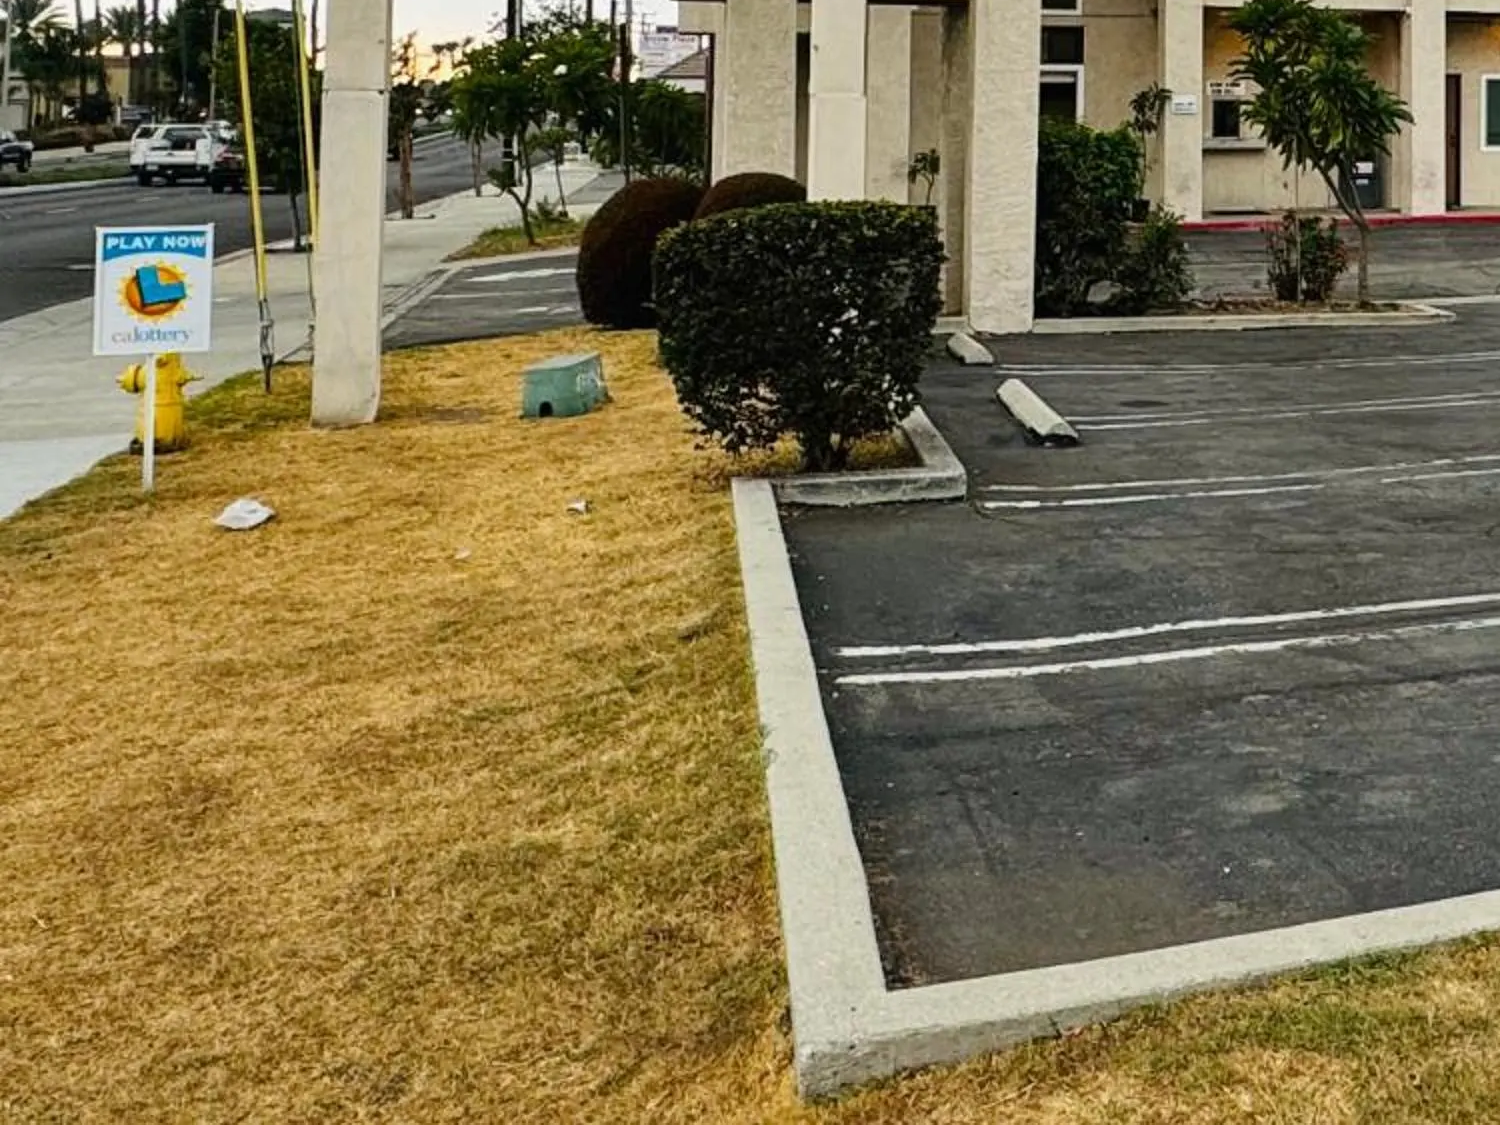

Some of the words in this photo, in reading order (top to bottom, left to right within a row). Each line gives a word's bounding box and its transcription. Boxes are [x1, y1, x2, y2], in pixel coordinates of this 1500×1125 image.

[106, 235, 157, 250] PLAY
[163, 234, 206, 249] NOW
[111, 326, 191, 345] calottery
